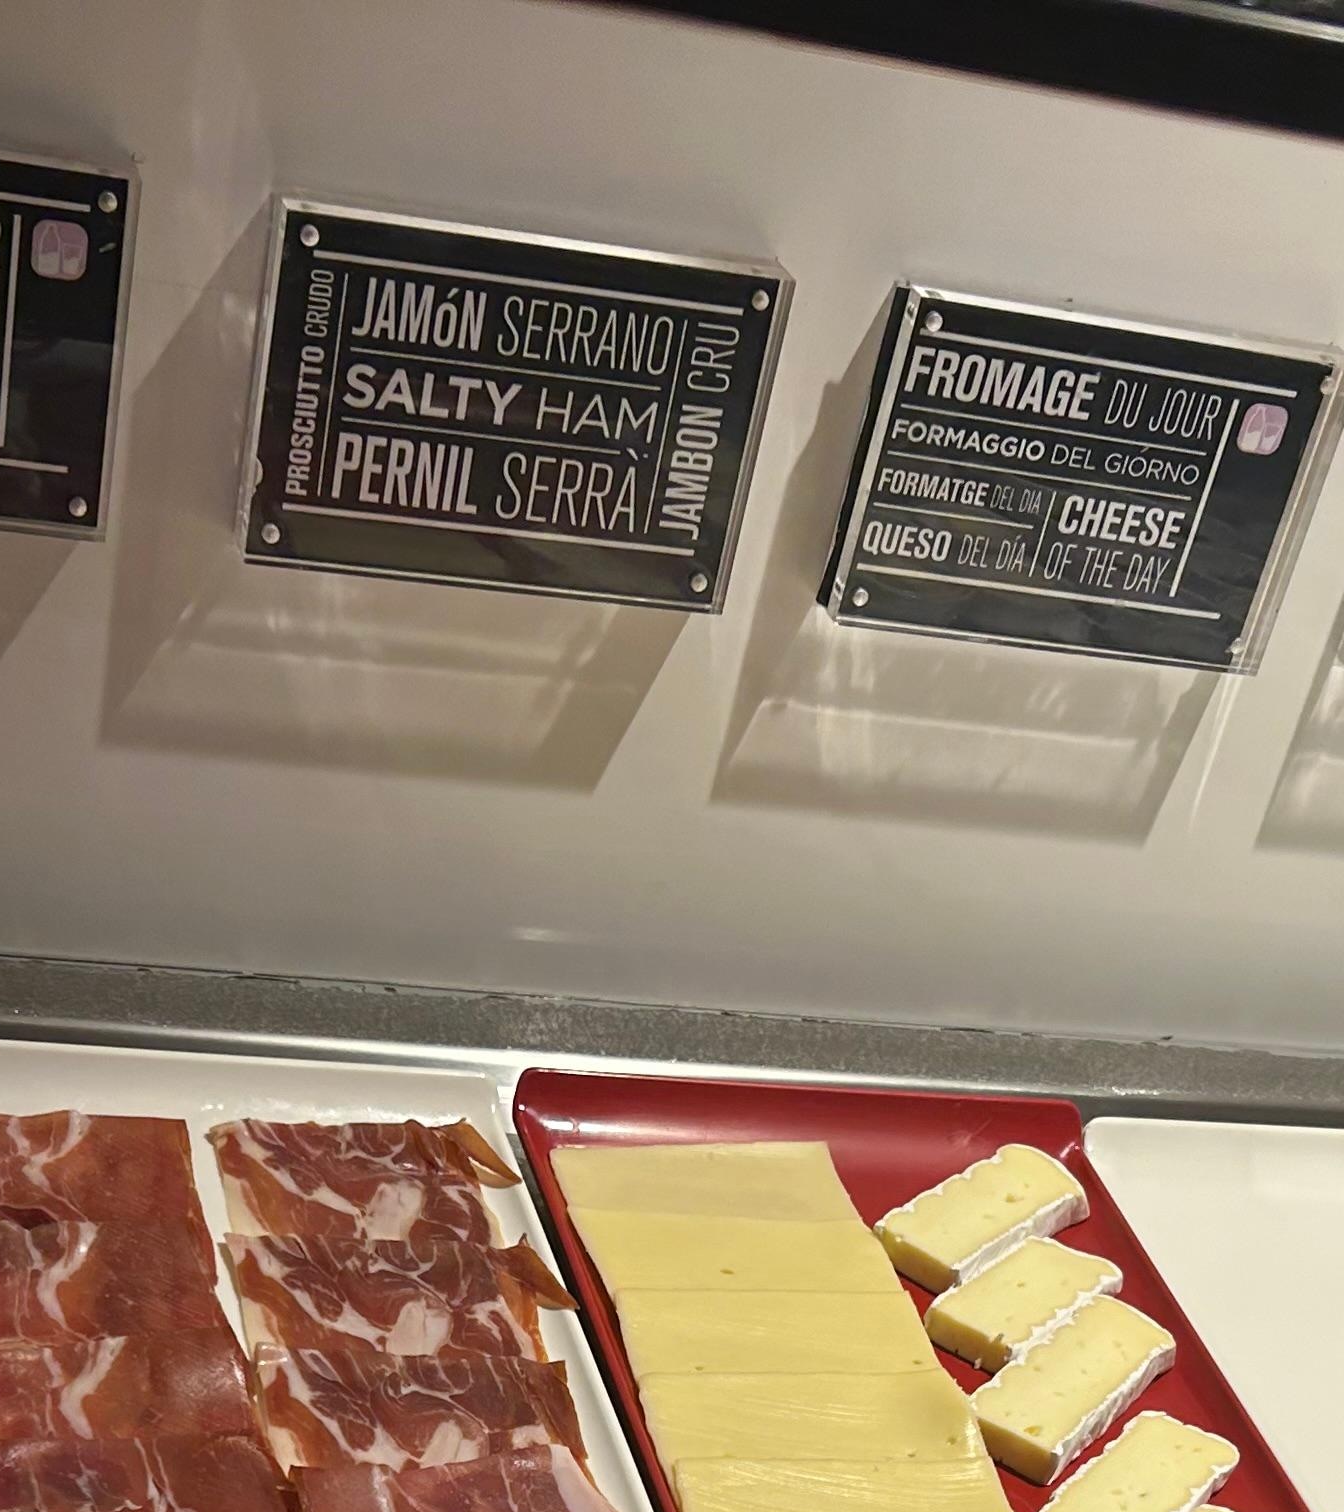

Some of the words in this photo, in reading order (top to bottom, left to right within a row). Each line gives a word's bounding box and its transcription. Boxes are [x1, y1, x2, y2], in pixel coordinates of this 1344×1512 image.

[304, 268, 335, 338] CRUDO
[496, 295, 674, 376] SERRANO
[688, 322, 740, 393] CRU
[285, 345, 326, 497] PROSCIUTTO
[342, 363, 523, 426] SALTY
[536, 391, 659, 444] HAM
[904, 346, 1100, 421] FROMAGE
[1104, 378, 1149, 431] DU
[1148, 388, 1222, 441] JOUR
[659, 404, 725, 540] JAMBON
[891, 418, 1046, 461] FORMAGGIO
[1051, 443, 1096, 471] DEL
[331, 432, 477, 515] PERNIL
[495, 448, 641, 534] SERRÀ
[877, 468, 989, 508] FORMATGE
[990, 484, 1016, 510] DEL
[1018, 487, 1042, 513] DIA
[862, 521, 952, 563] QUESO
[957, 535, 994, 570] DEL
[995, 533, 1026, 574] DÍA
[1057, 494, 1186, 550] CHEESE
[1043, 541, 1075, 580] OF
[1080, 546, 1118, 589] THE
[1122, 552, 1173, 595] DAY
